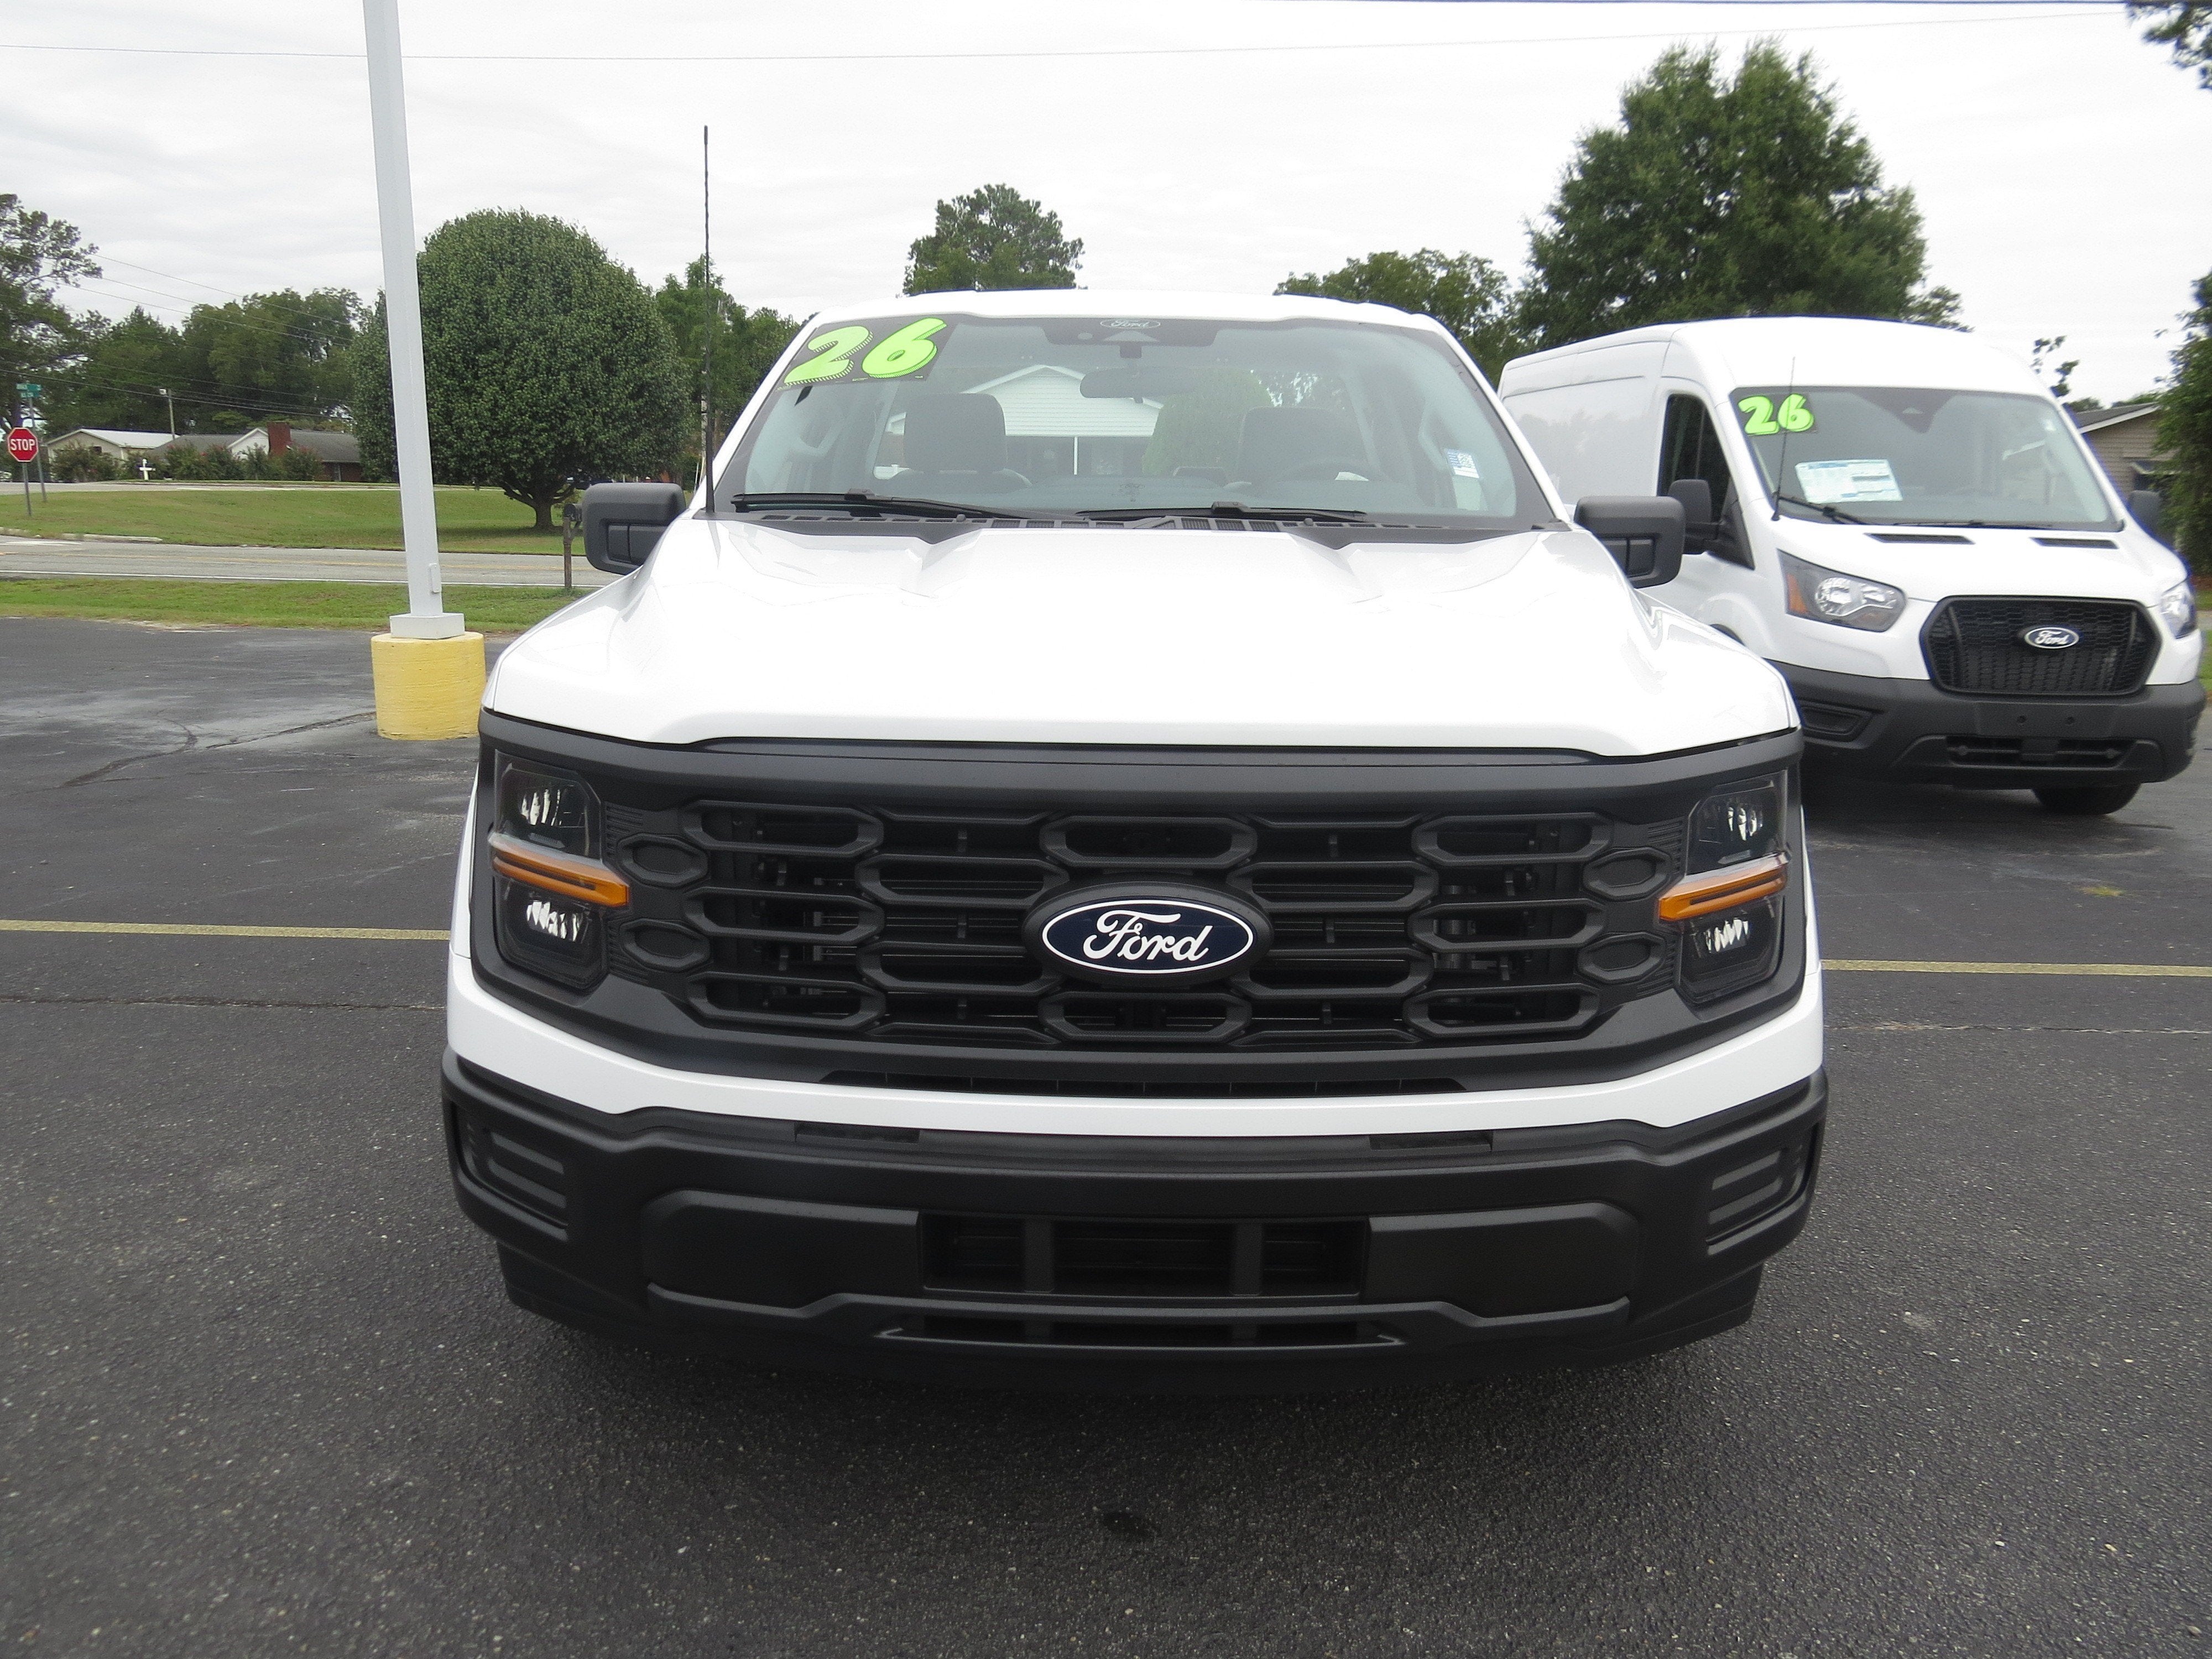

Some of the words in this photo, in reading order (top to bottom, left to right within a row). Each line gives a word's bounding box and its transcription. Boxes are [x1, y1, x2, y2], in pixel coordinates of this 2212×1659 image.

[784, 317, 947, 385] 26
[1738, 393, 1814, 435] 26
[10, 439, 35, 451] STOP
[2035, 630, 2070, 645] Ford
[1083, 910, 1213, 961] Ford
